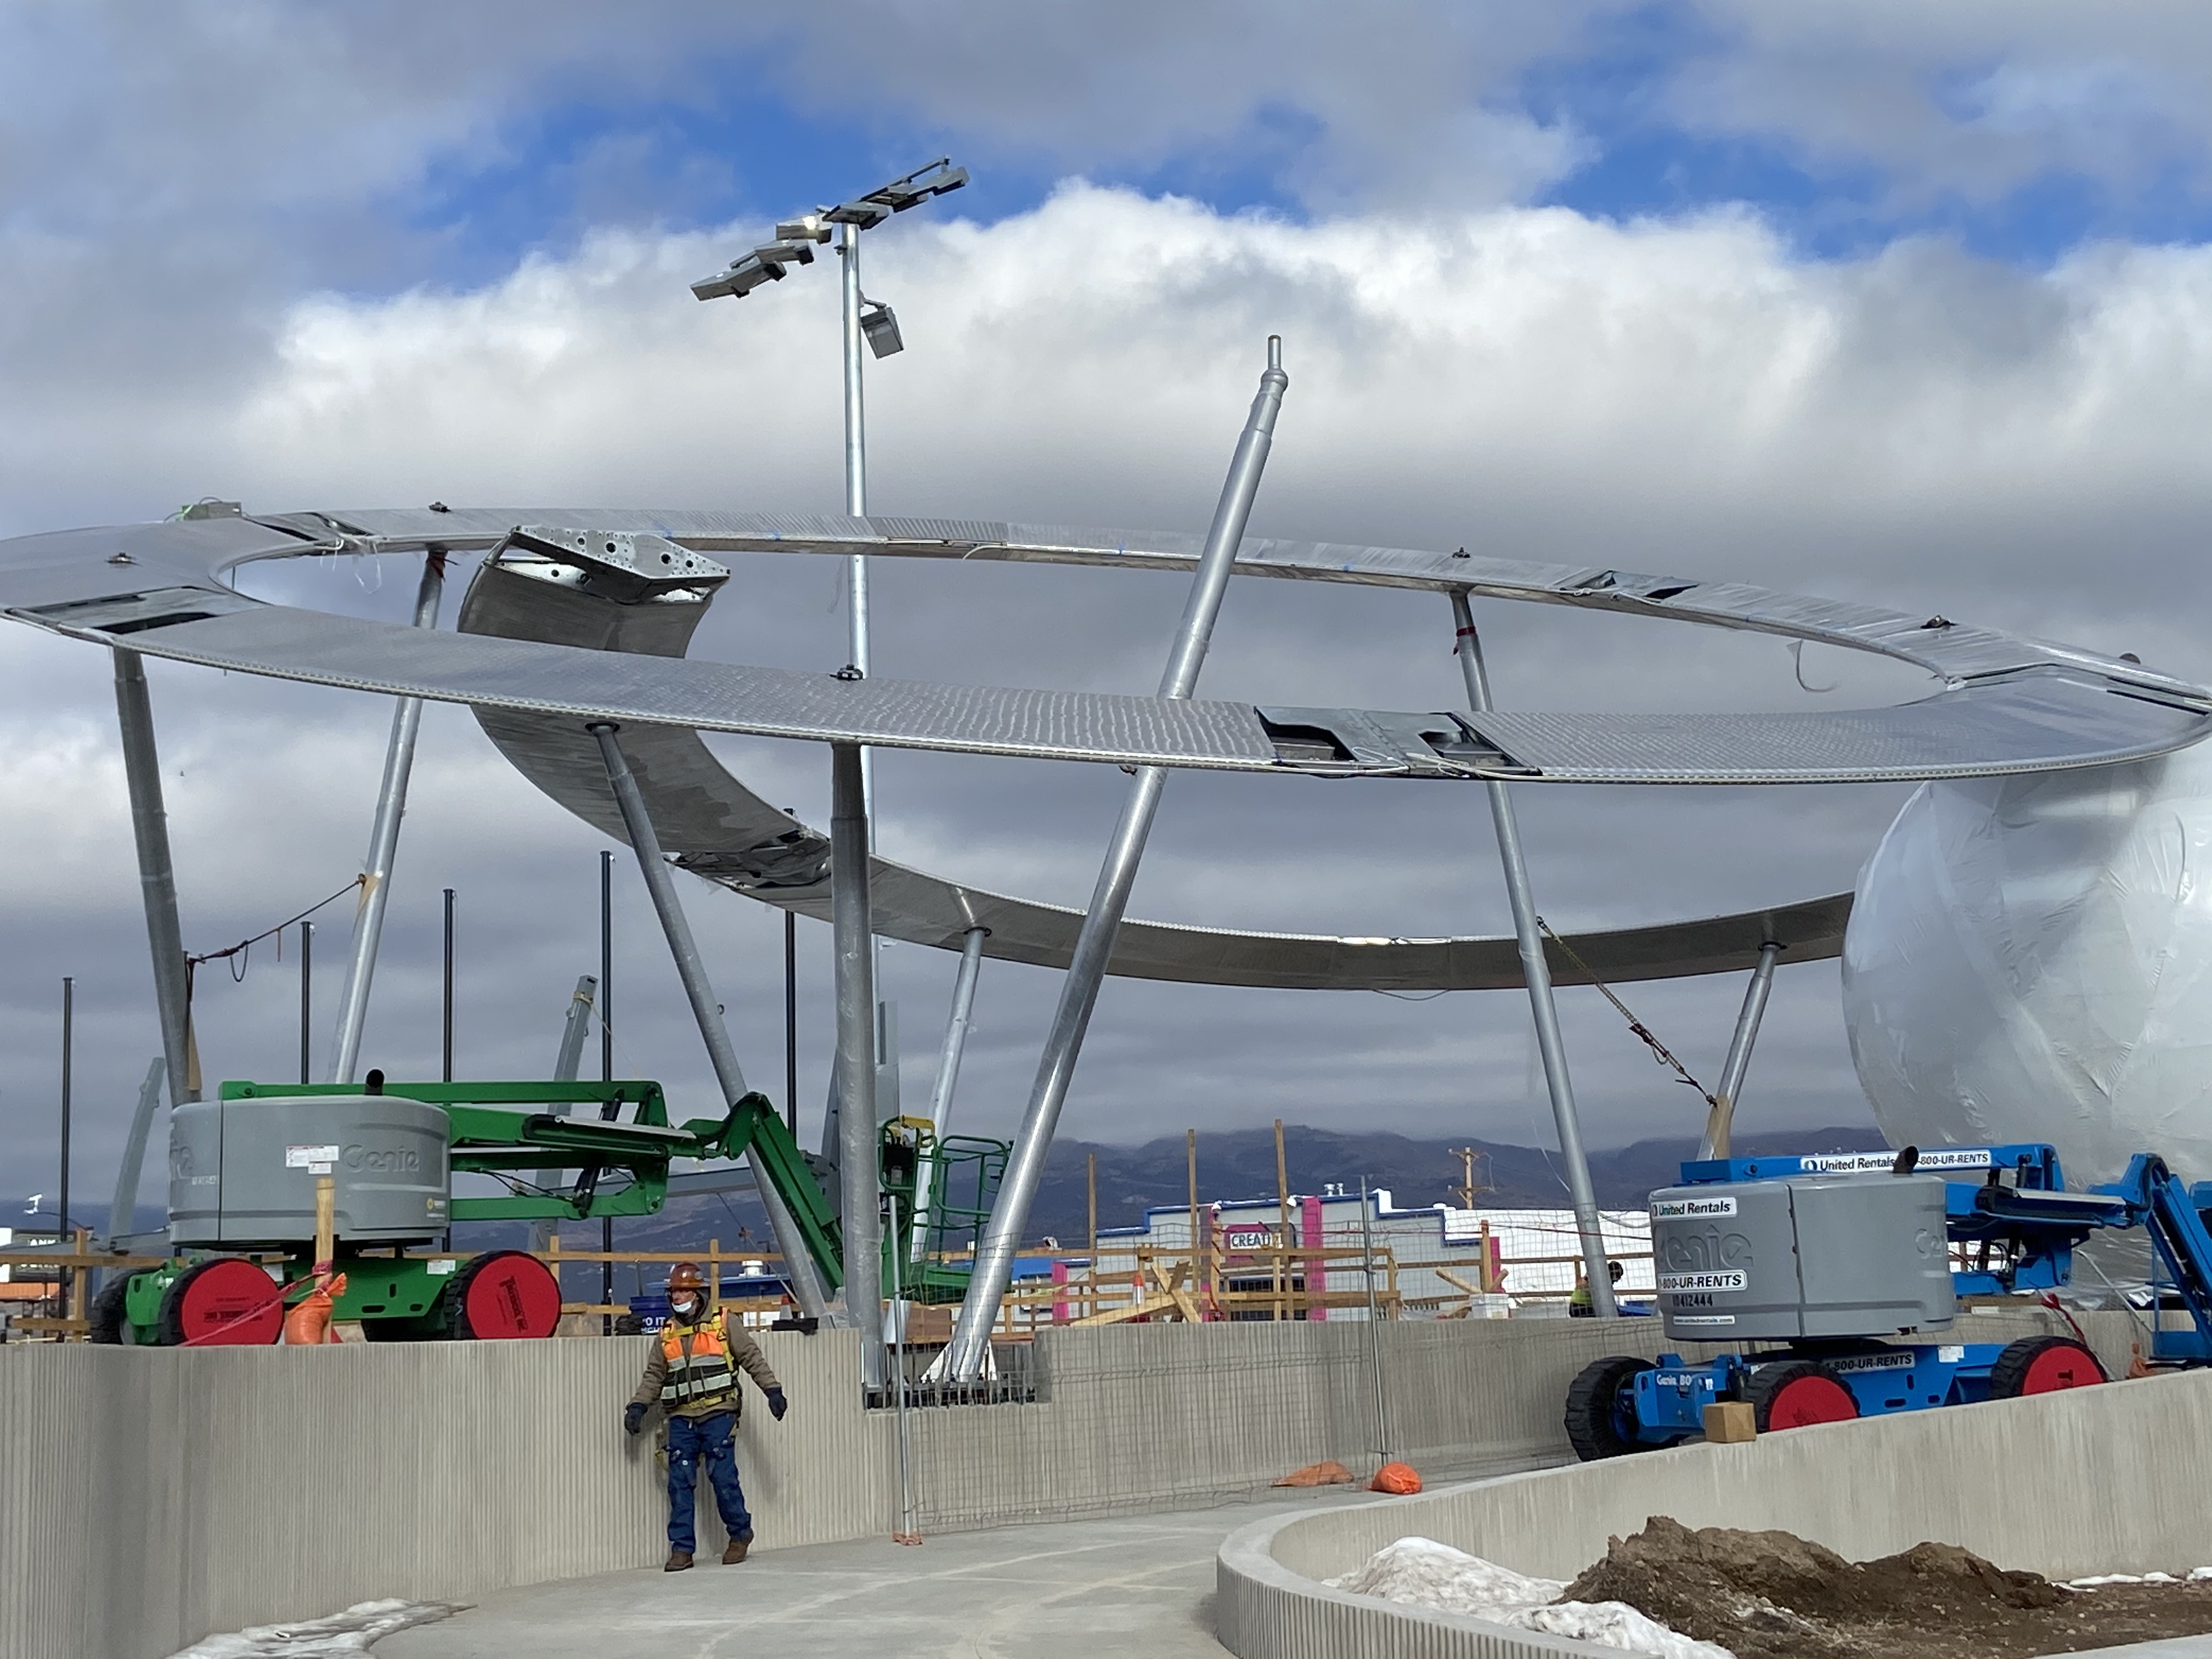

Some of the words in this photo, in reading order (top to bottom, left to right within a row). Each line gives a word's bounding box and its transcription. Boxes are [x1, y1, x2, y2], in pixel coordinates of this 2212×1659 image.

[342, 1144, 420, 1173] Genie
[1820, 1157, 1854, 1171] United
[1858, 1154, 1894, 1168] Rentals
[1917, 1154, 1989, 1165] -800-UR-RENTS
[1659, 1203, 1685, 1216] United
[1688, 1200, 1730, 1214] Rentals
[1232, 1232, 1279, 1247] CREATI
[1826, 1354, 1912, 1371] 1800-UR-RENTS
